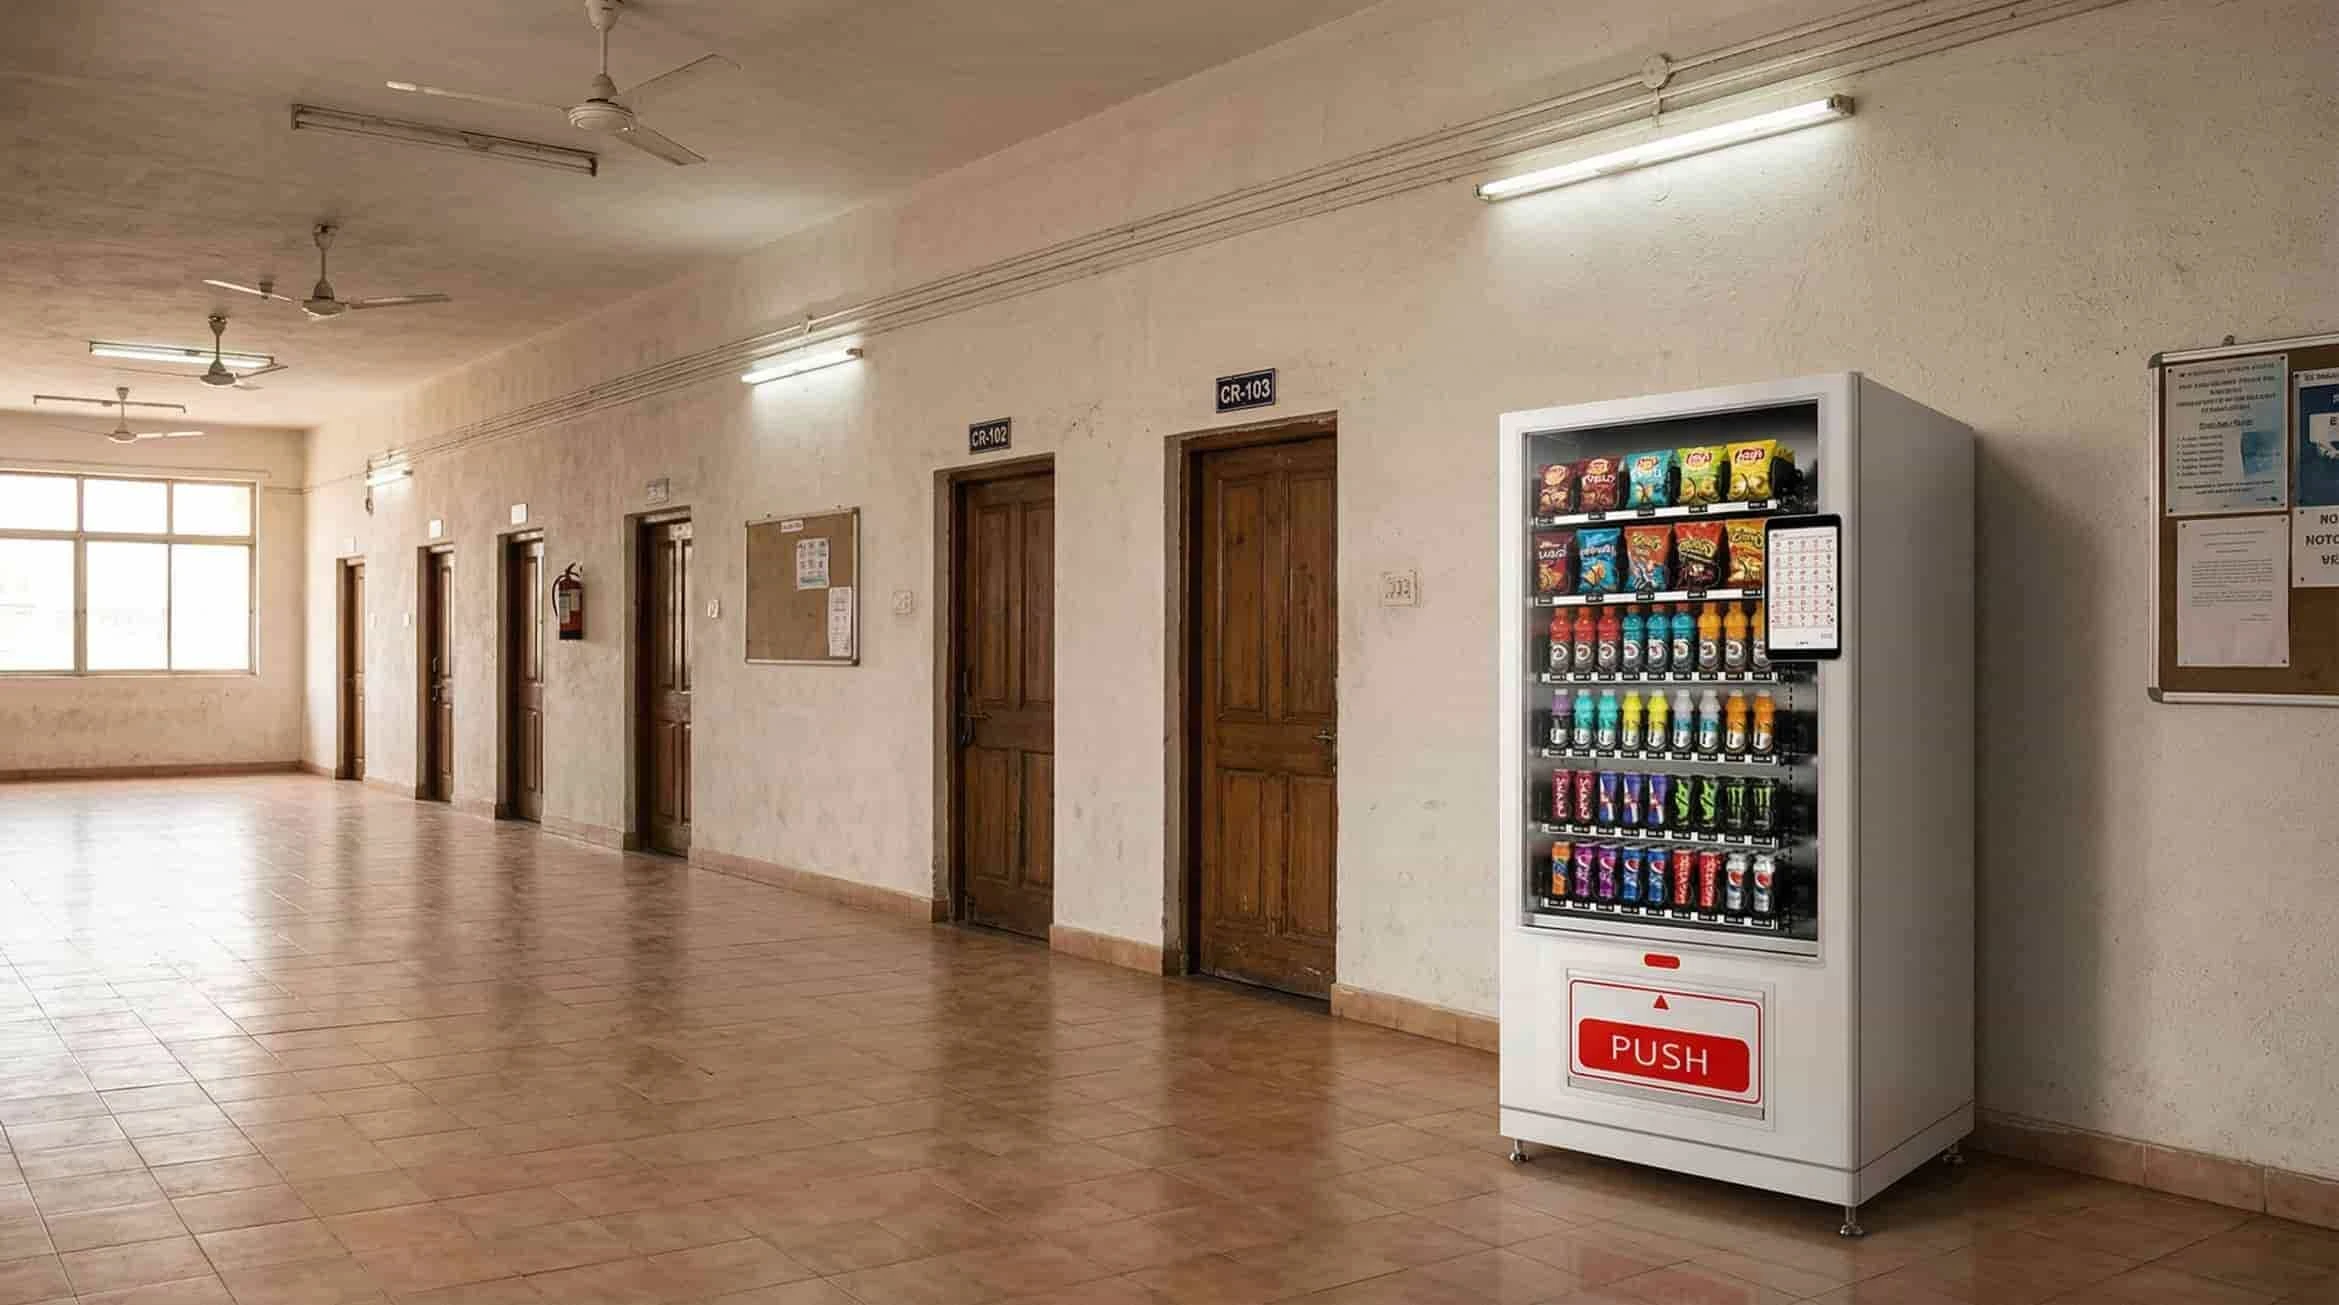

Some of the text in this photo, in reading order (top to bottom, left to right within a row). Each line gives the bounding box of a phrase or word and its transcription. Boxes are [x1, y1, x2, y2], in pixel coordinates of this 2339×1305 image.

[1221, 378, 1271, 404] CR-103
[971, 426, 1008, 447] CR-102
[1612, 1035, 1708, 1075] PUSH
